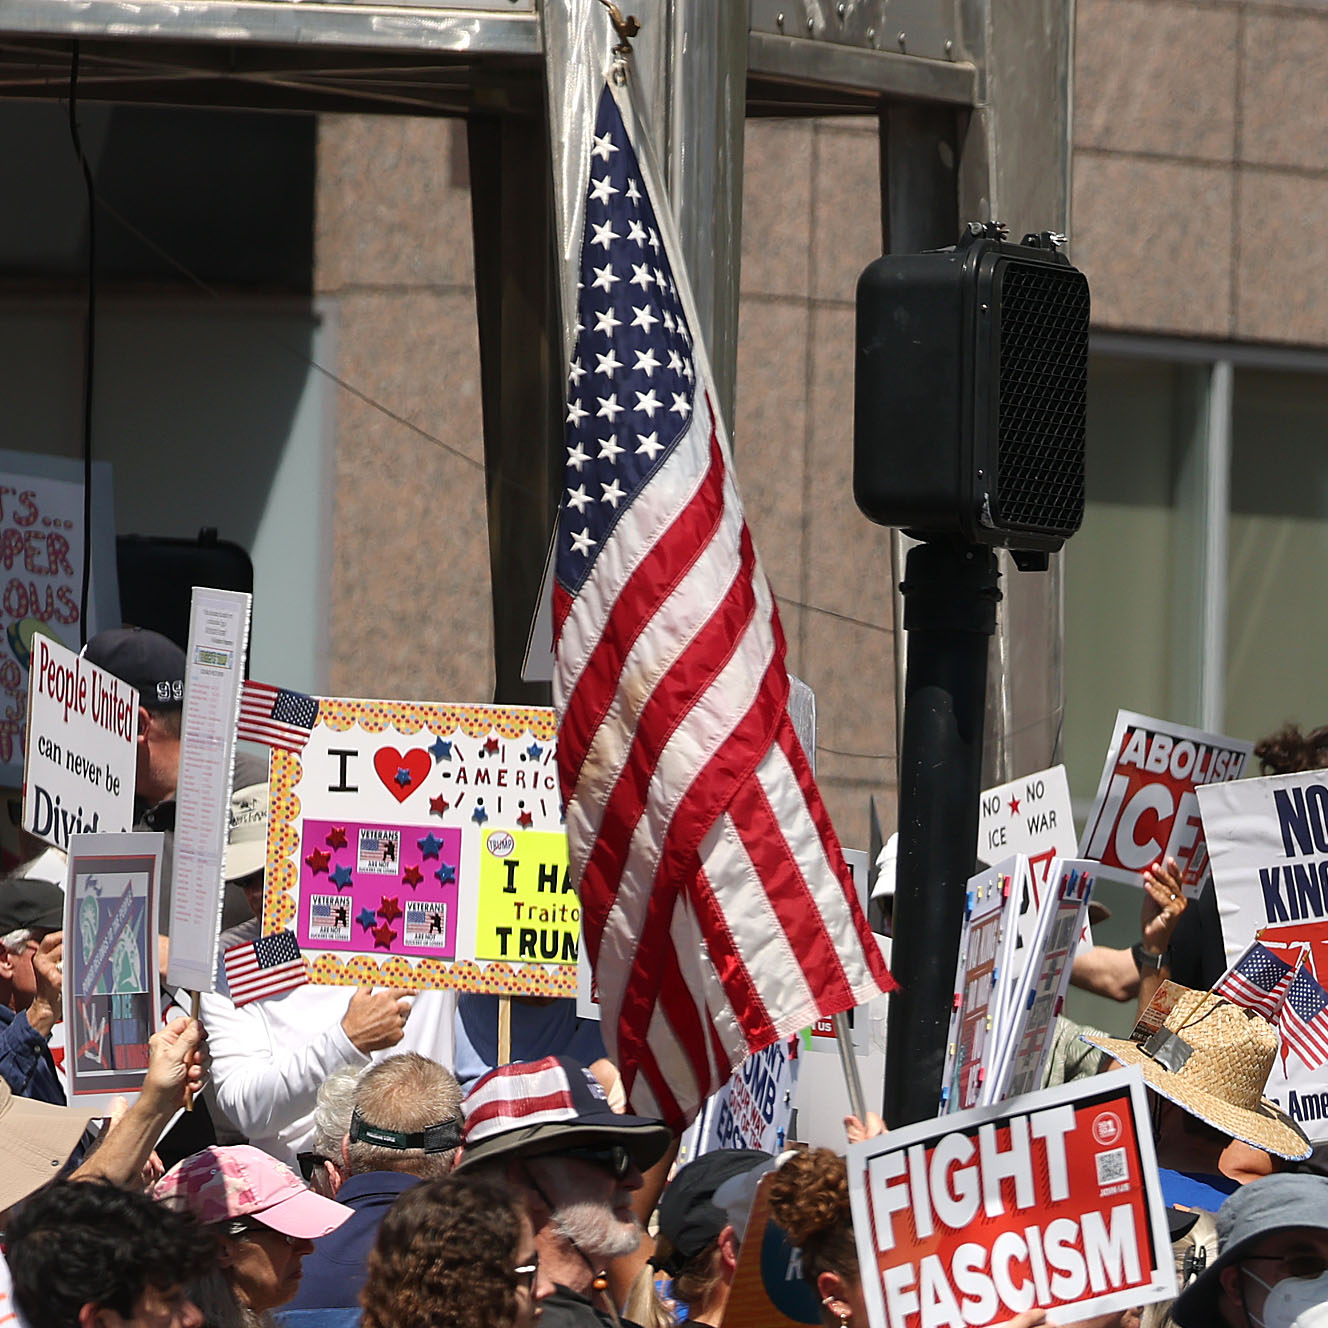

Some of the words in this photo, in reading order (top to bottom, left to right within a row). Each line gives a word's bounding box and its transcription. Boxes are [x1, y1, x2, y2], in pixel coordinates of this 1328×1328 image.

[38, 641, 88, 723] People
[91, 670, 134, 743] United
[38, 735, 62, 766] can
[66, 751, 102, 785] never
[106, 764, 120, 796] be
[327, 748, 359, 793] I
[1119, 728, 1245, 784] ABOLISH
[32, 784, 129, 848] Divid
[982, 796, 1001, 818] NO
[1026, 780, 1045, 804] NO
[361, 830, 398, 840] VETERANS
[488, 838, 513, 850] TRUMP
[988, 826, 1007, 850] ICE
[1027, 810, 1058, 836] WAR
[503, 860, 519, 893] I
[312, 896, 349, 905] VETERANS
[408, 902, 445, 912] VETERANS
[818, 1022, 833, 1032] US
[869, 1105, 1077, 1253] FIGHT
